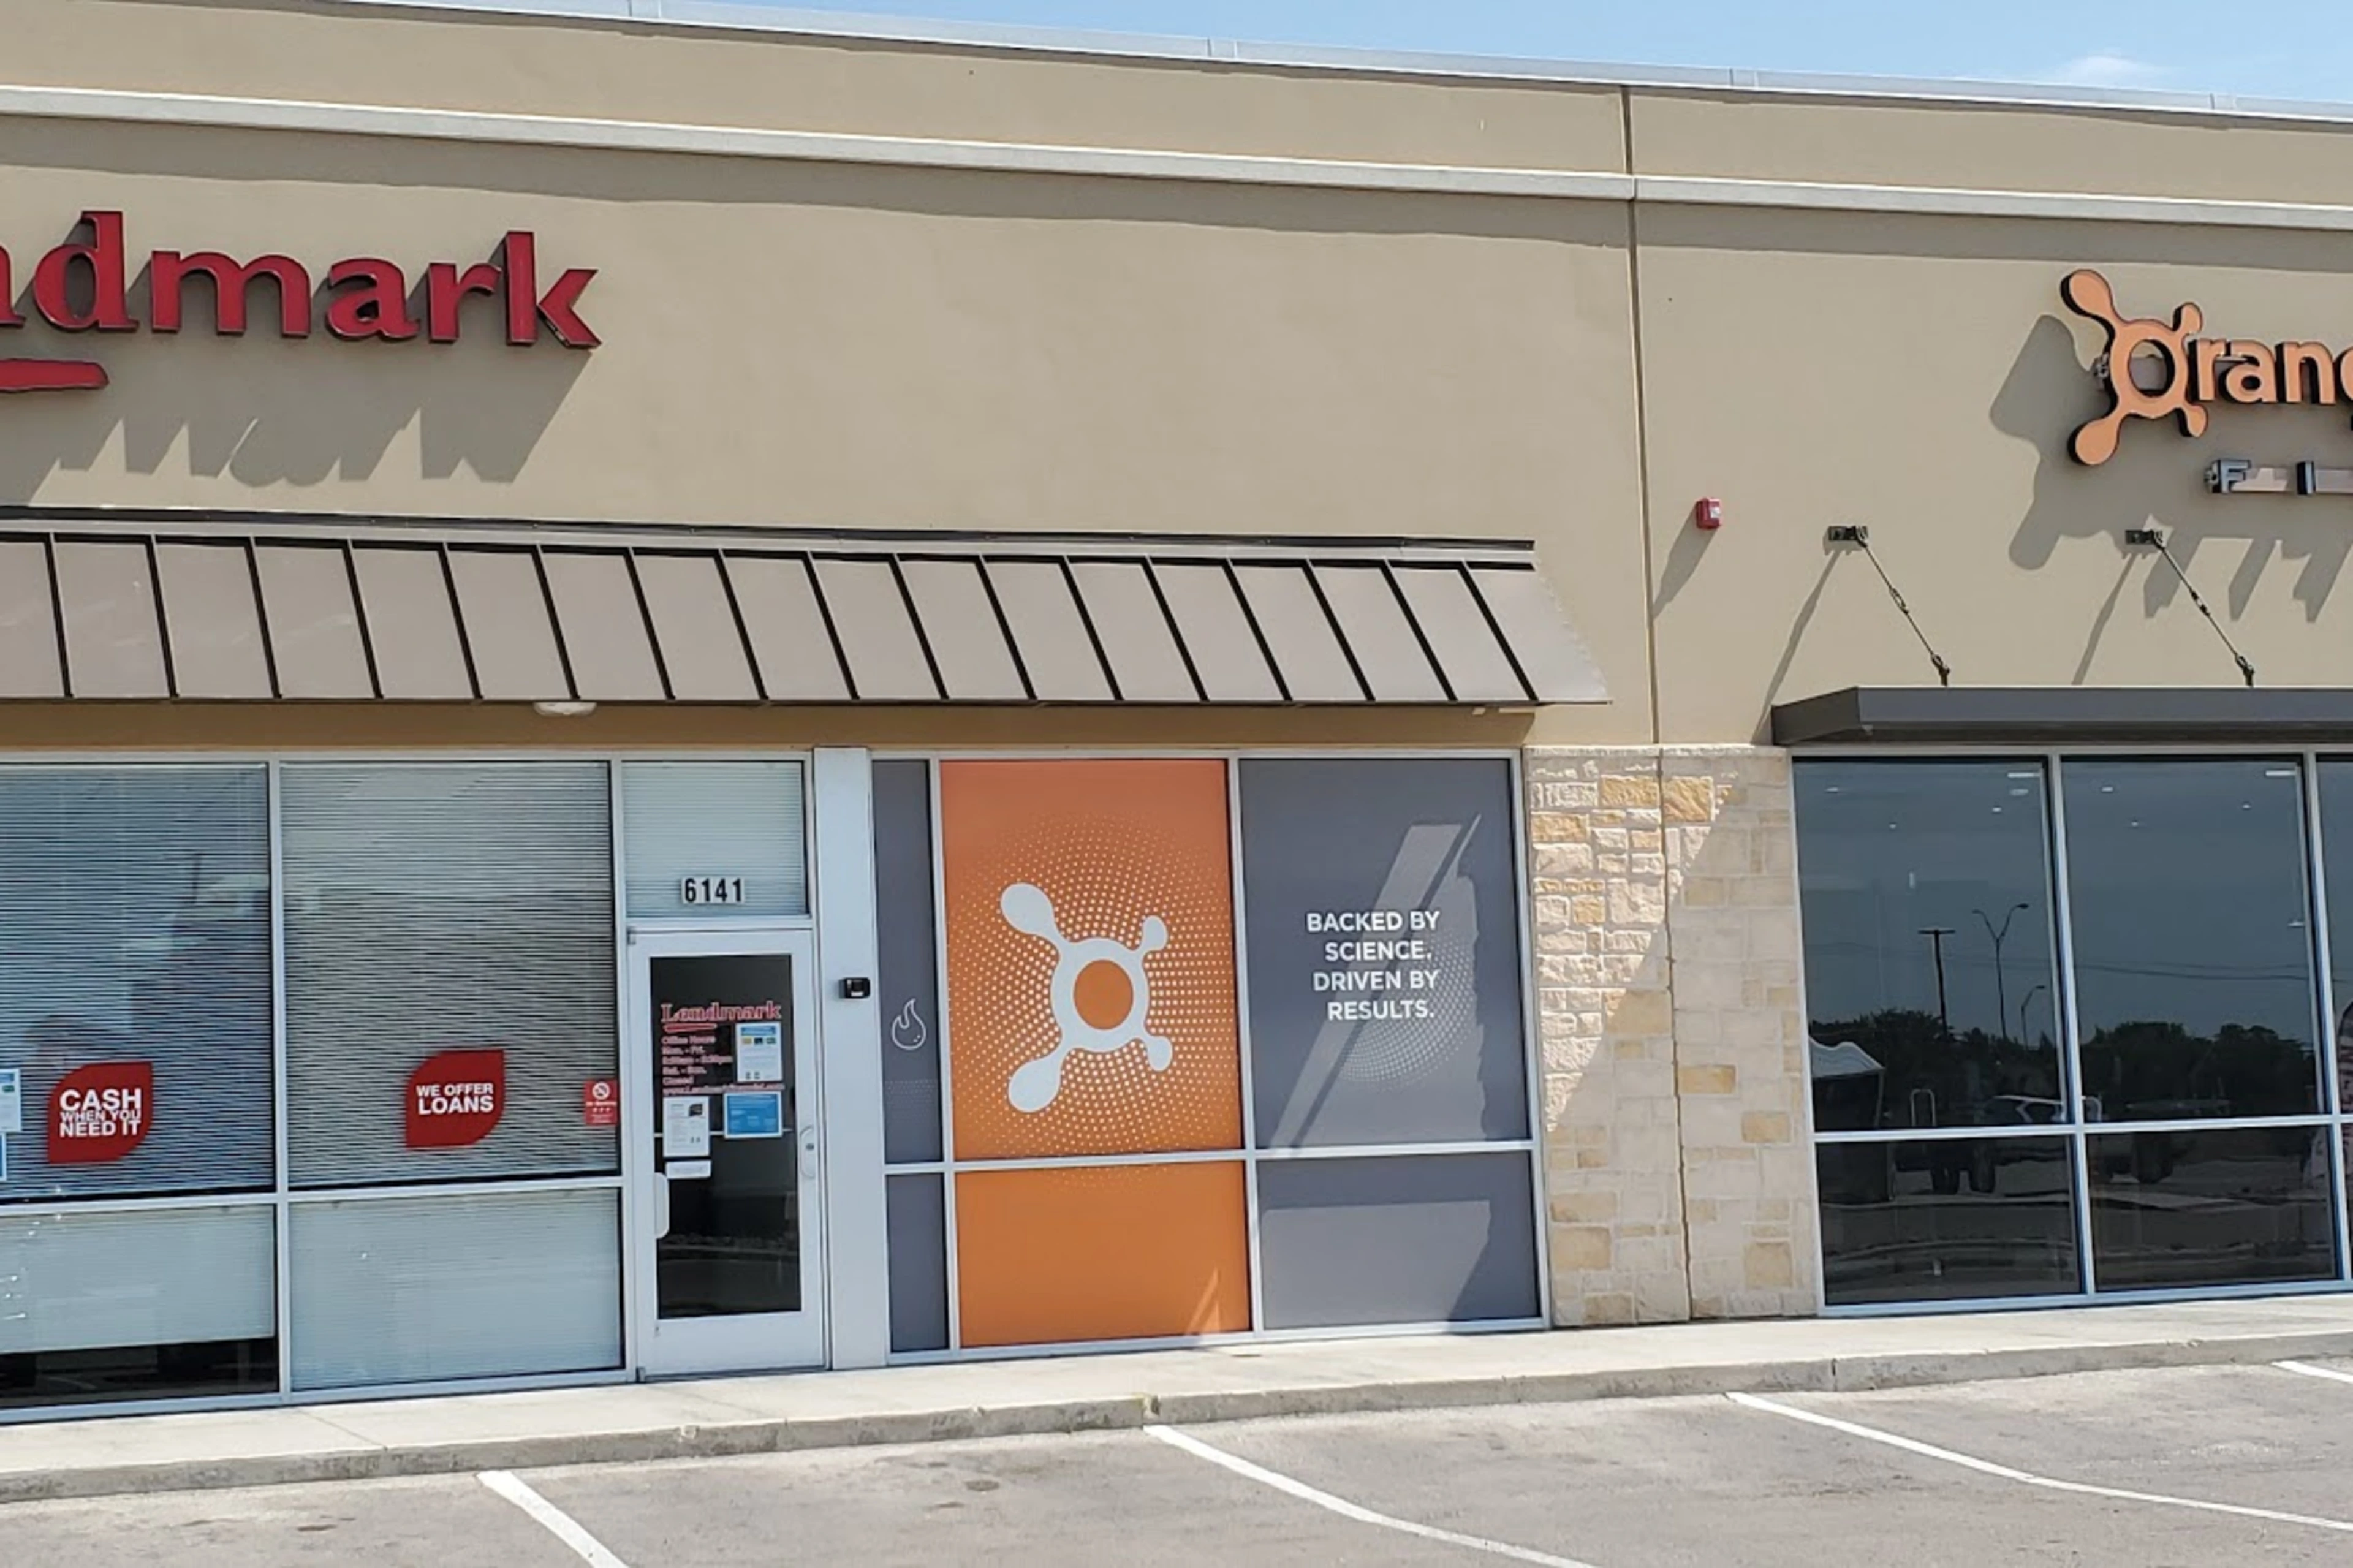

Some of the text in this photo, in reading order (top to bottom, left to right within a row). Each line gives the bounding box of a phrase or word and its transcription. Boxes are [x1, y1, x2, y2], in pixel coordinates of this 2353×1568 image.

[684, 877, 743, 903] 6141
[1306, 911, 1440, 932] BACKED BY
[1313, 970, 1440, 991] DRIVEN BY
[1327, 1000, 1434, 1020] RESULTS.
[416, 1082, 493, 1097] WE OFFER
[59, 1088, 142, 1112] CASH
[419, 1095, 494, 1114] LOANS
[60, 1108, 141, 1123] WHEN YOU
[60, 1119, 141, 1137] NEED IT
